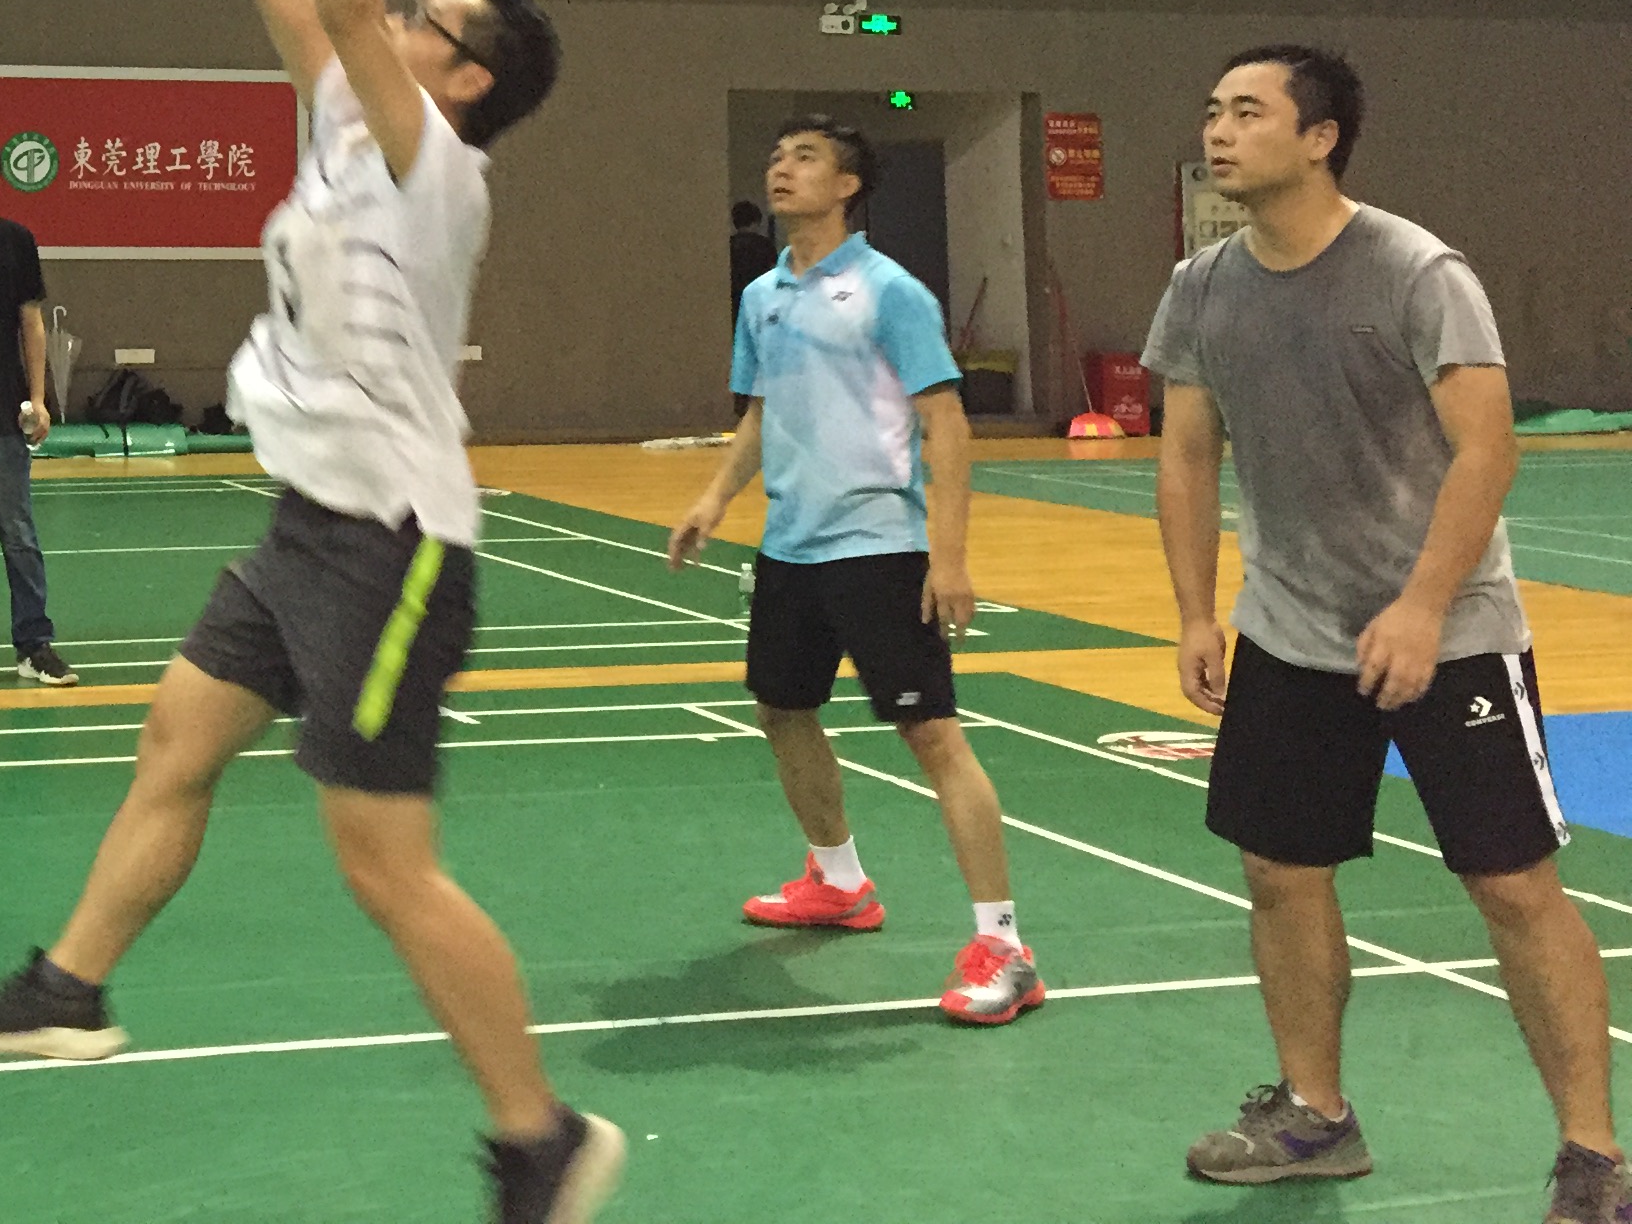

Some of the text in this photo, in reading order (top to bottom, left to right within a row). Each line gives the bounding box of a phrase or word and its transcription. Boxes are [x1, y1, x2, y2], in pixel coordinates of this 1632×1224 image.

[69, 136, 256, 180] 東莞理工學院
[123, 180, 175, 190] UNIVERSITY
[180, 181, 192, 190] OF
[198, 181, 256, 191] TECHNOLOGY
